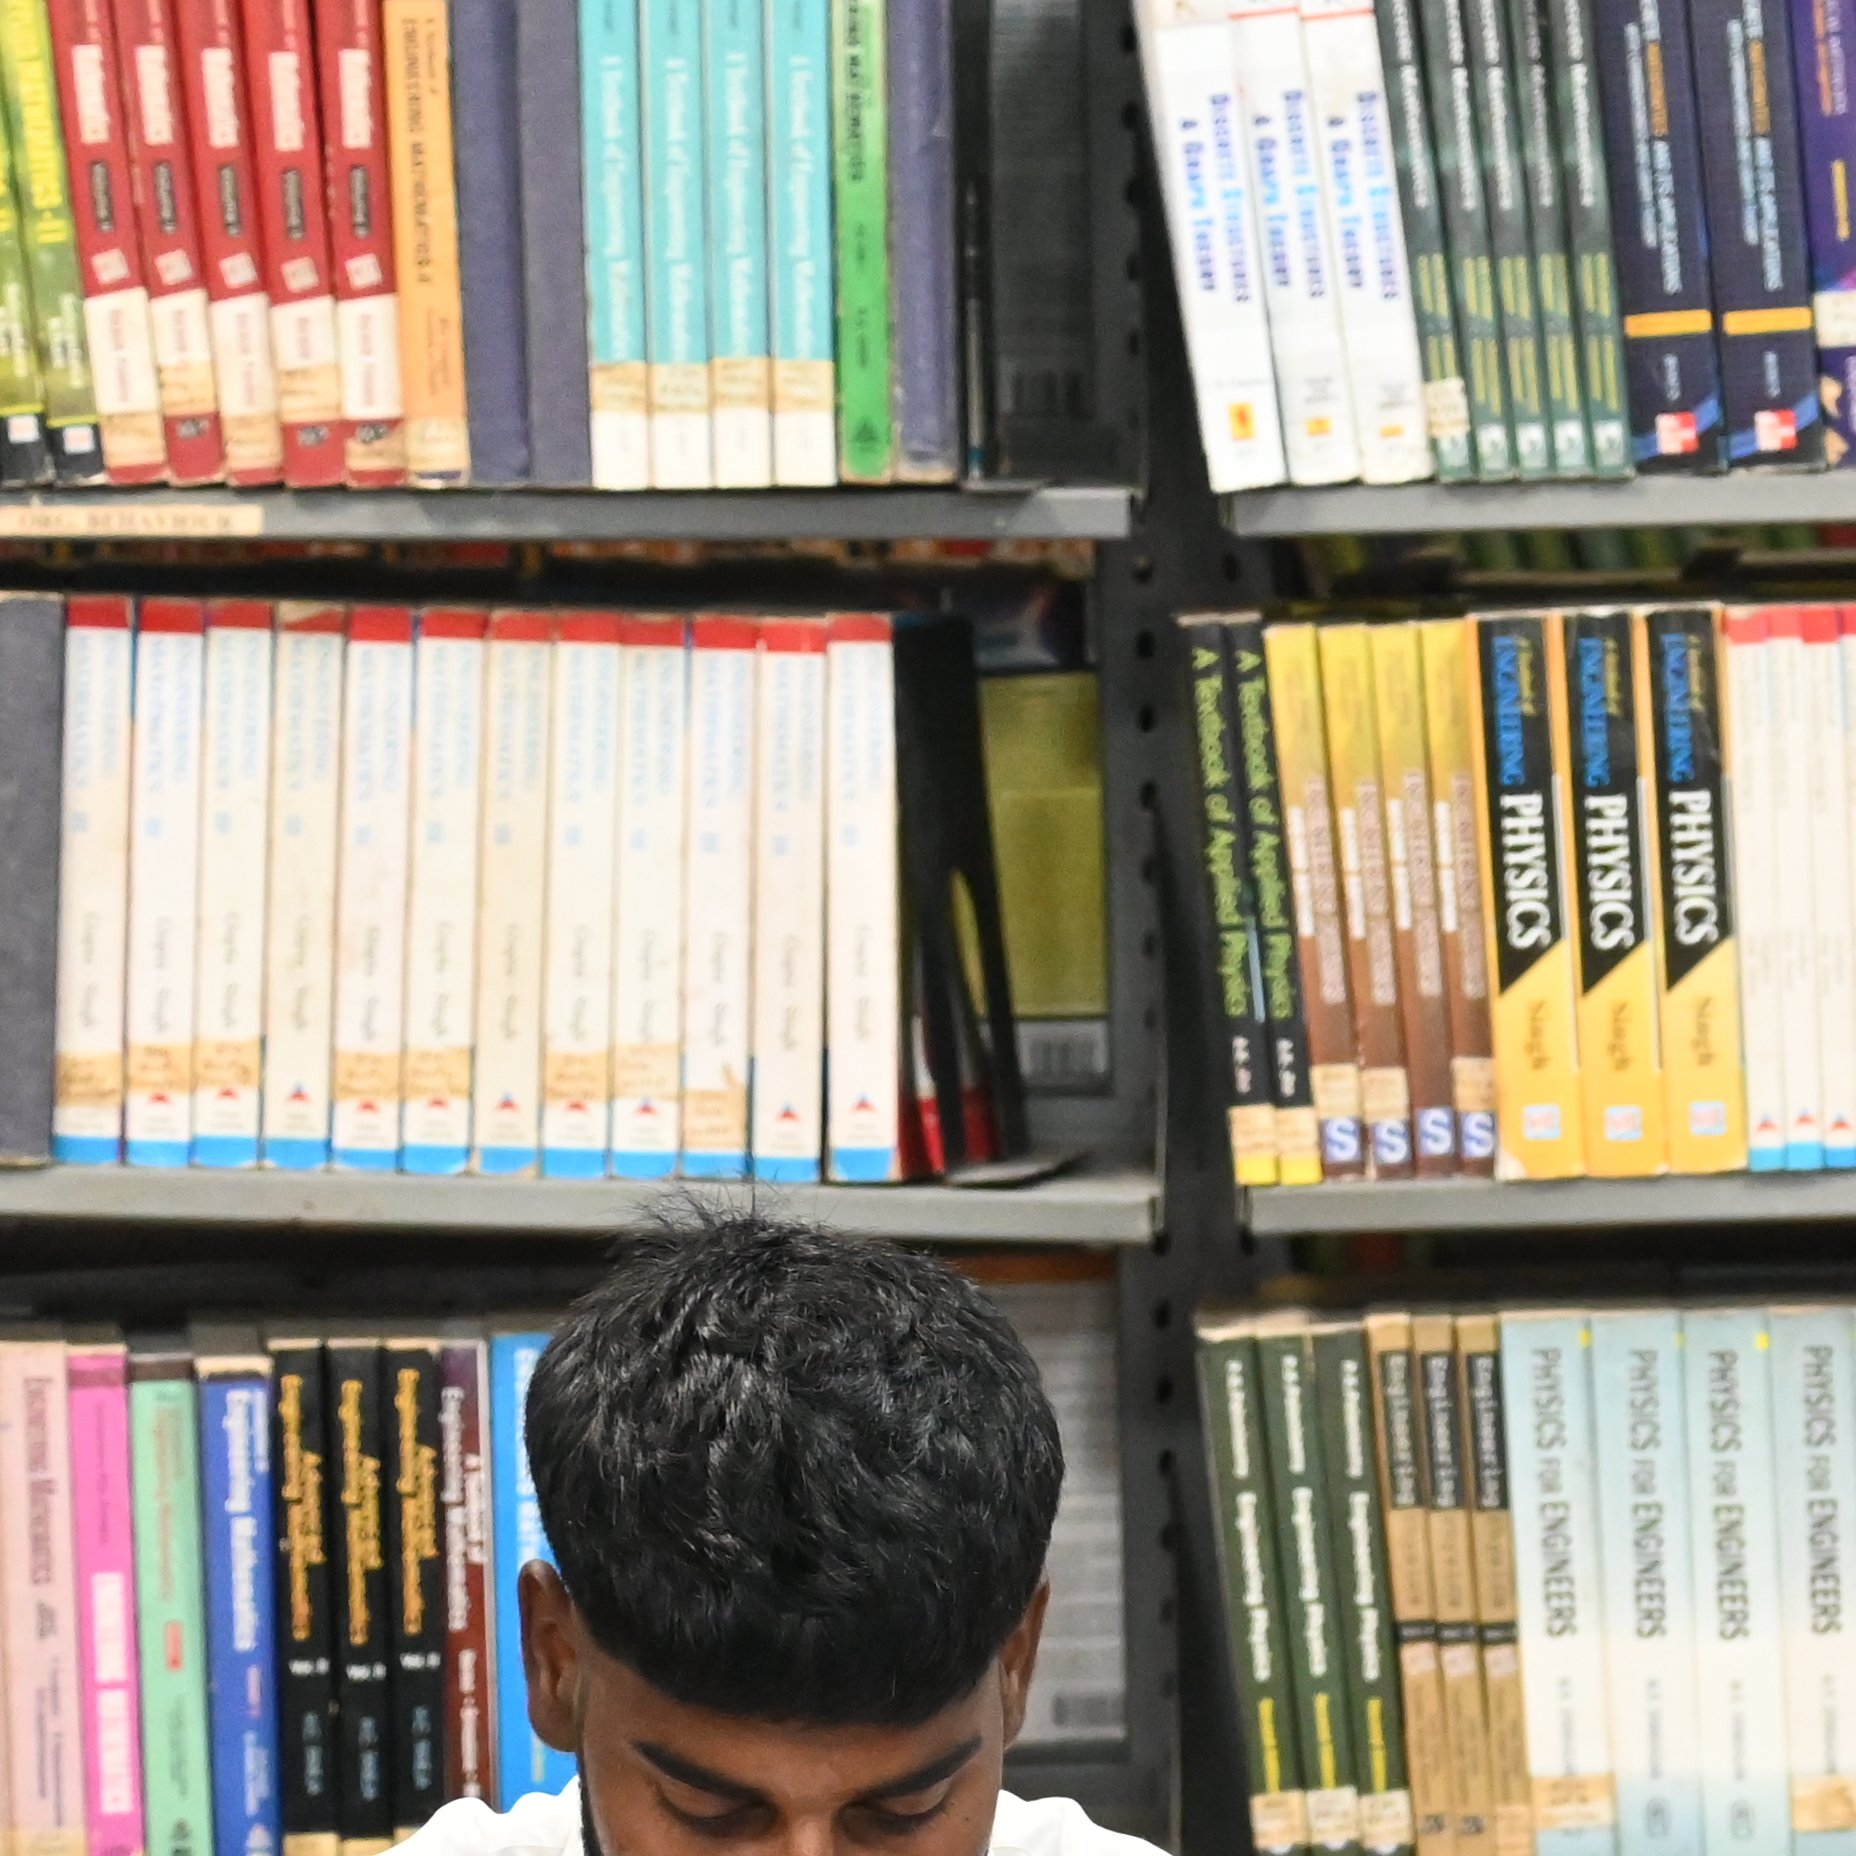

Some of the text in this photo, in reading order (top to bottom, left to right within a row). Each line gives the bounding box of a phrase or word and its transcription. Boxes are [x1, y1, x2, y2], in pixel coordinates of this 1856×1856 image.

[1493, 637, 1526, 784] ENGINEERING
[1579, 639, 1610, 786] ENGINEERING
[1662, 634, 1694, 782] ENGINEERING
[1191, 647, 1250, 1017] A Textbook of Applied Physics
[1236, 650, 1294, 1019] A Textbook of Applied Physics
[1499, 794, 1549, 948] PHYSICS
[1585, 795, 1634, 950] PHYSICS
[1668, 791, 1718, 945] PHYSICS
[1523, 1001, 1549, 1070] Singh
[1610, 1002, 1632, 1071] Singh
[1693, 997, 1716, 1066] Singh
[282, 1376, 305, 1500] Engineering
[339, 1381, 363, 1506] Engineering
[395, 1369, 419, 1494] Engineering
[1388, 1353, 1416, 1507] Engineering
[1429, 1354, 1459, 1507] Engineering
[1469, 1356, 1504, 1507] Engineering
[1531, 1350, 1576, 1638] PHYSICS FOR ENGINEERS
[1629, 1351, 1666, 1639] PHYSICS FOR ENGINEERS
[1709, 1351, 1749, 1640] PHYSICS FOR ENGINEERS
[1802, 1346, 1841, 1634] PHYSICS FOR ENGINEERS
[224, 1391, 257, 1651] Engineering Mathematics
[441, 1387, 467, 1632] Engineering Mathematics
[1291, 1488, 1328, 1677] Engineering Physics
[1349, 1491, 1382, 1682] Engineering Physics
[1236, 1493, 1272, 1682] Engineering Physics
